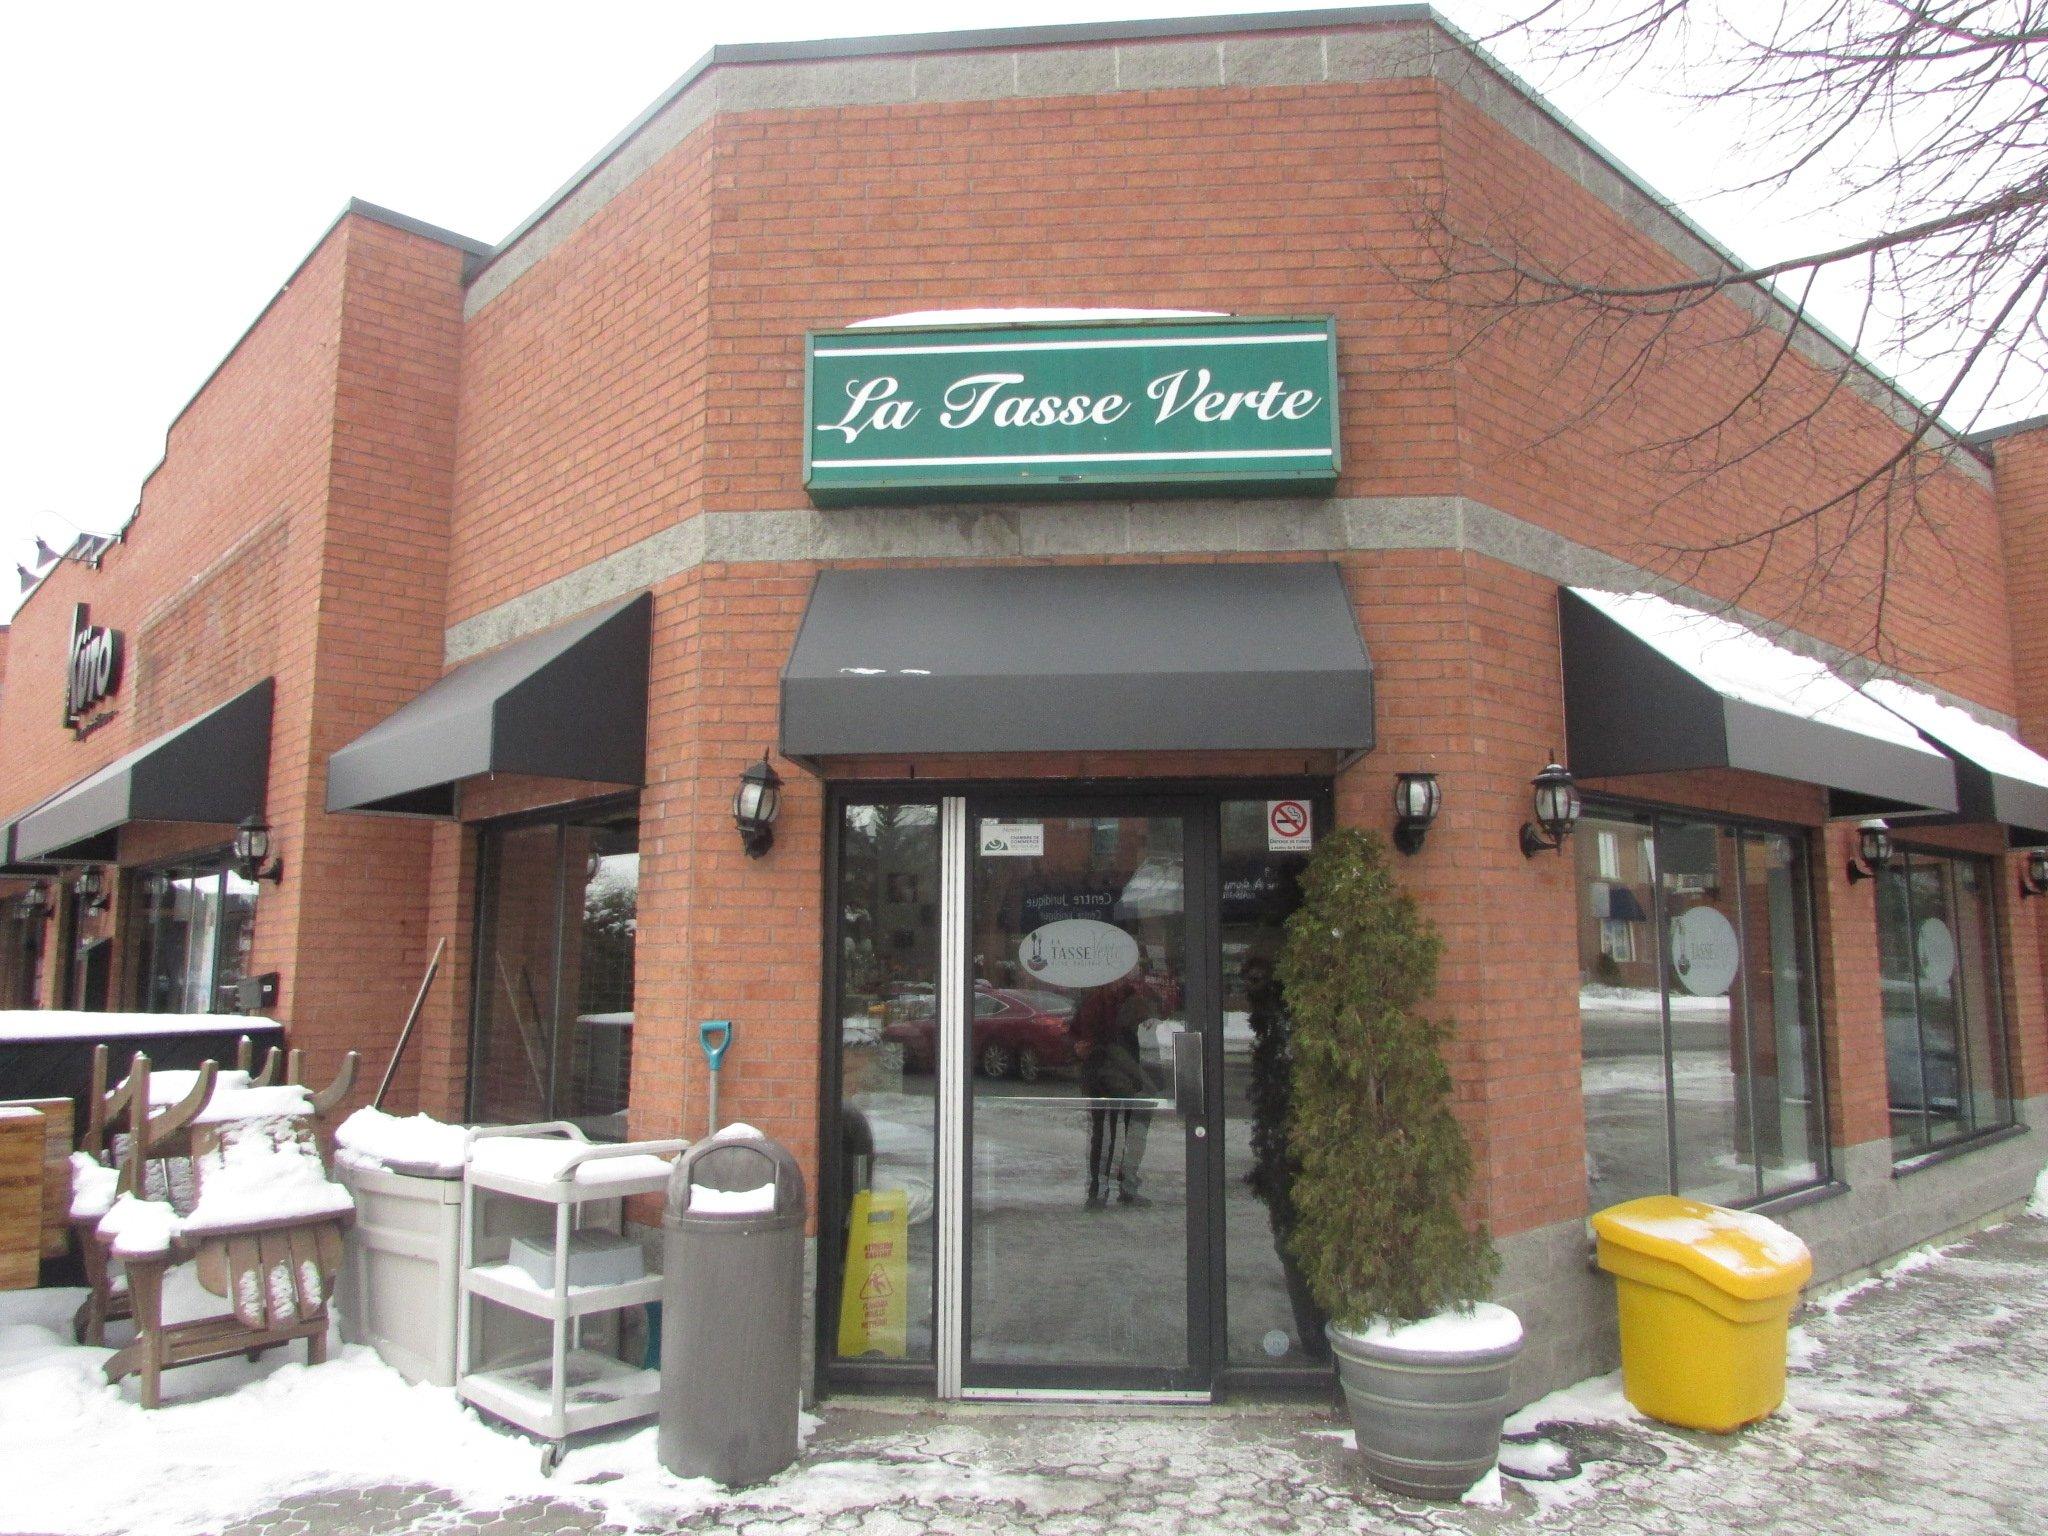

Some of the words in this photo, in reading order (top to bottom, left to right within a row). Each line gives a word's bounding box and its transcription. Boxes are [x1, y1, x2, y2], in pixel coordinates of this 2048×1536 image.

[816, 376, 922, 444] La
[939, 372, 1132, 429] Tasse
[1146, 367, 1322, 426] Verte
[1048, 946, 1092, 960] TASSE
